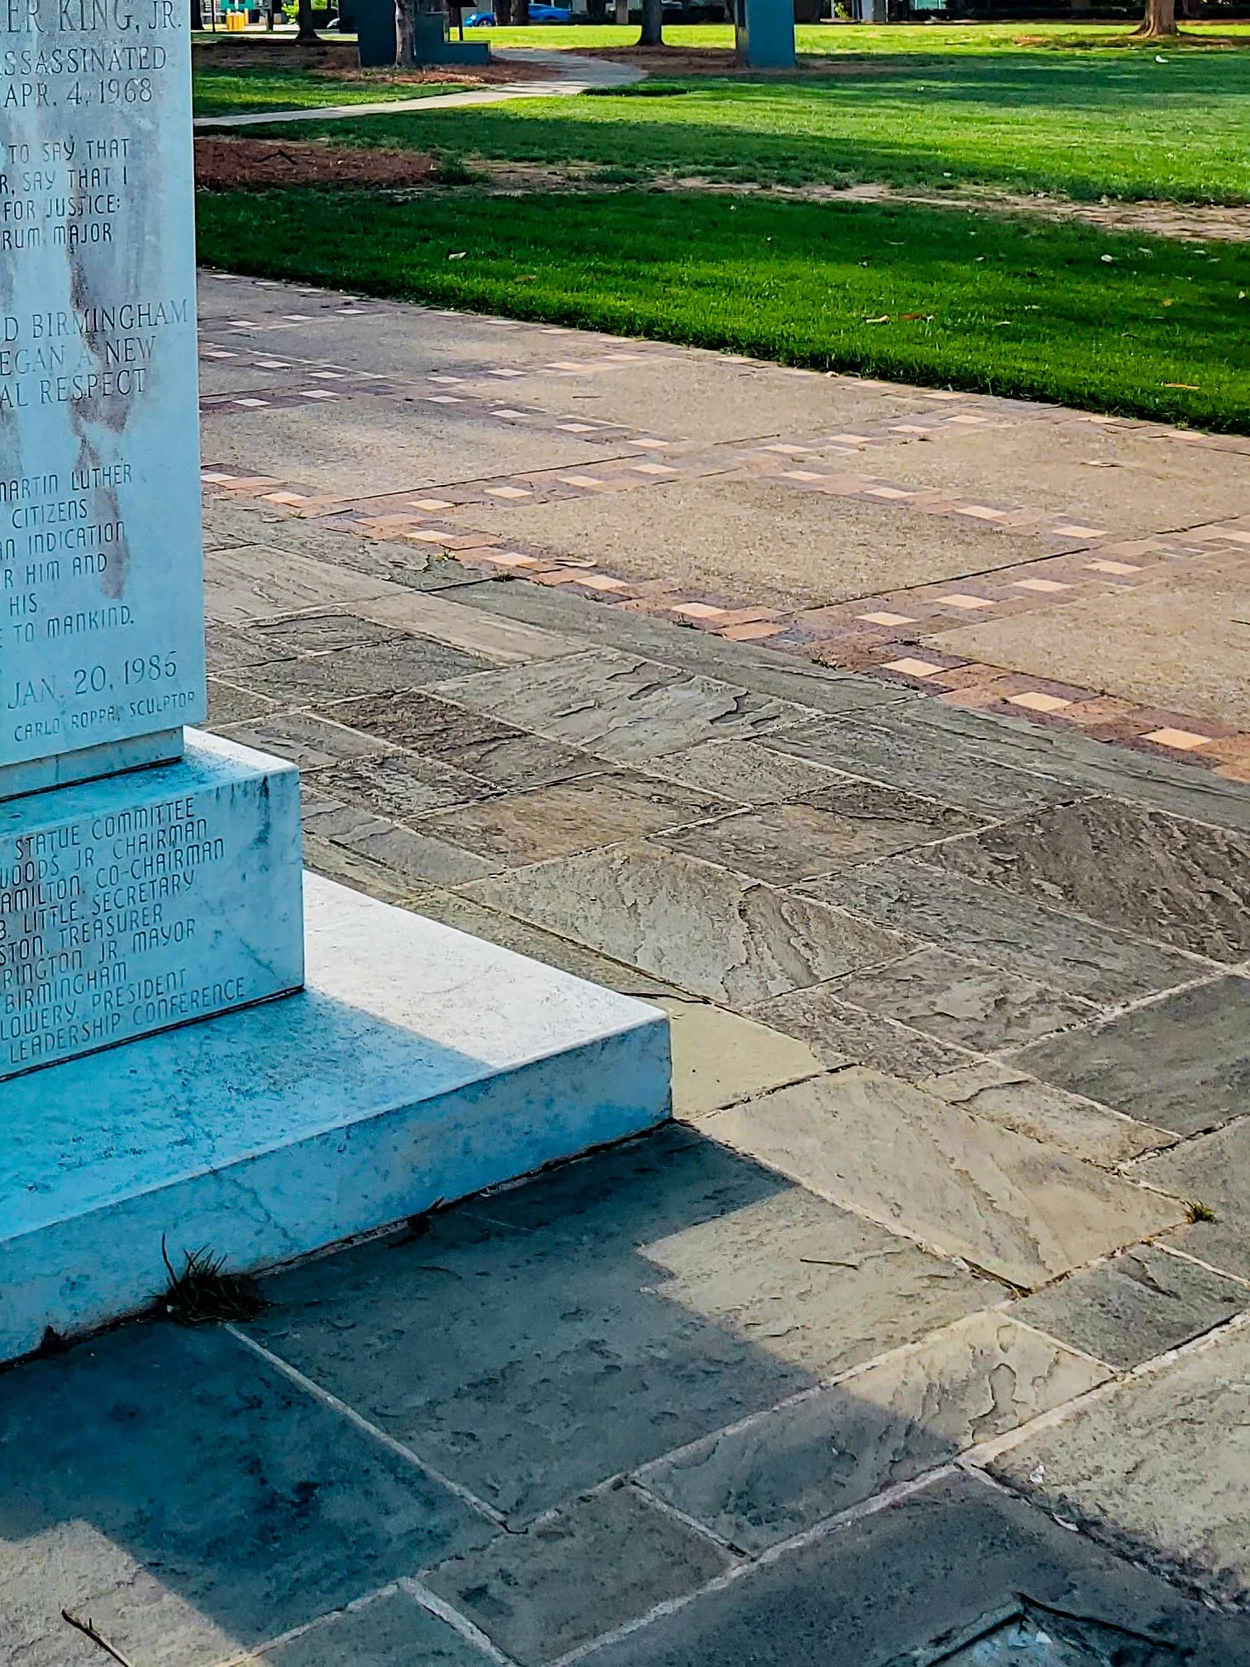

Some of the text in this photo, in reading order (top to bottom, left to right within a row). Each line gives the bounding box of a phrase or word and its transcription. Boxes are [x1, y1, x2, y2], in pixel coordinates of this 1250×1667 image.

[149, 0, 182, 29] JR.
[4, 83, 57, 108] APR.
[99, 78, 153, 104] 1968
[8, 144, 30, 164] TO
[42, 141, 75, 163] SAY
[86, 138, 130, 160] THAT
[22, 170, 56, 192] SAY
[67, 167, 111, 189] THAT
[122, 165, 128, 186] I
[4, 200, 35, 222] FOR
[53, 222, 112, 245] MAJOR
[32, 299, 188, 339] BIRMINGHAM
[77, 345, 93, 369] A
[105, 335, 156, 365] NEW
[40, 367, 147, 404] RESPECT
[71, 464, 132, 491] LUTHER
[12, 498, 88, 529] CITIZENS
[28, 521, 125, 555] INDICATION
[26, 560, 60, 585] HIM
[72, 553, 108, 577] AND
[9, 593, 38, 617] HIS
[14, 623, 35, 644] TO
[47, 605, 135, 638] MANKIND.
[7, 675, 64, 710] JAN.
[74, 665, 114, 695] 20,
[14, 718, 61, 742] CARLO
[129, 691, 195, 717] SCULPTOR
[15, 825, 81, 860] STATUE
[92, 797, 195, 840] COMMITTEE
[113, 818, 207, 860] CHAIRMAN
[96, 838, 224, 889] CO-CHAIRMAN
[92, 870, 194, 915] SECRETARY
[58, 903, 163, 948] TREASURER
[132, 918, 196, 954] MAYOR
[5, 961, 126, 1014] BIRMINGHAM
[92, 968, 186, 1013] PRESIDENT
[10, 1013, 121, 1063] LEADERSHIP
[133, 977, 246, 1026] CONFERENCE
